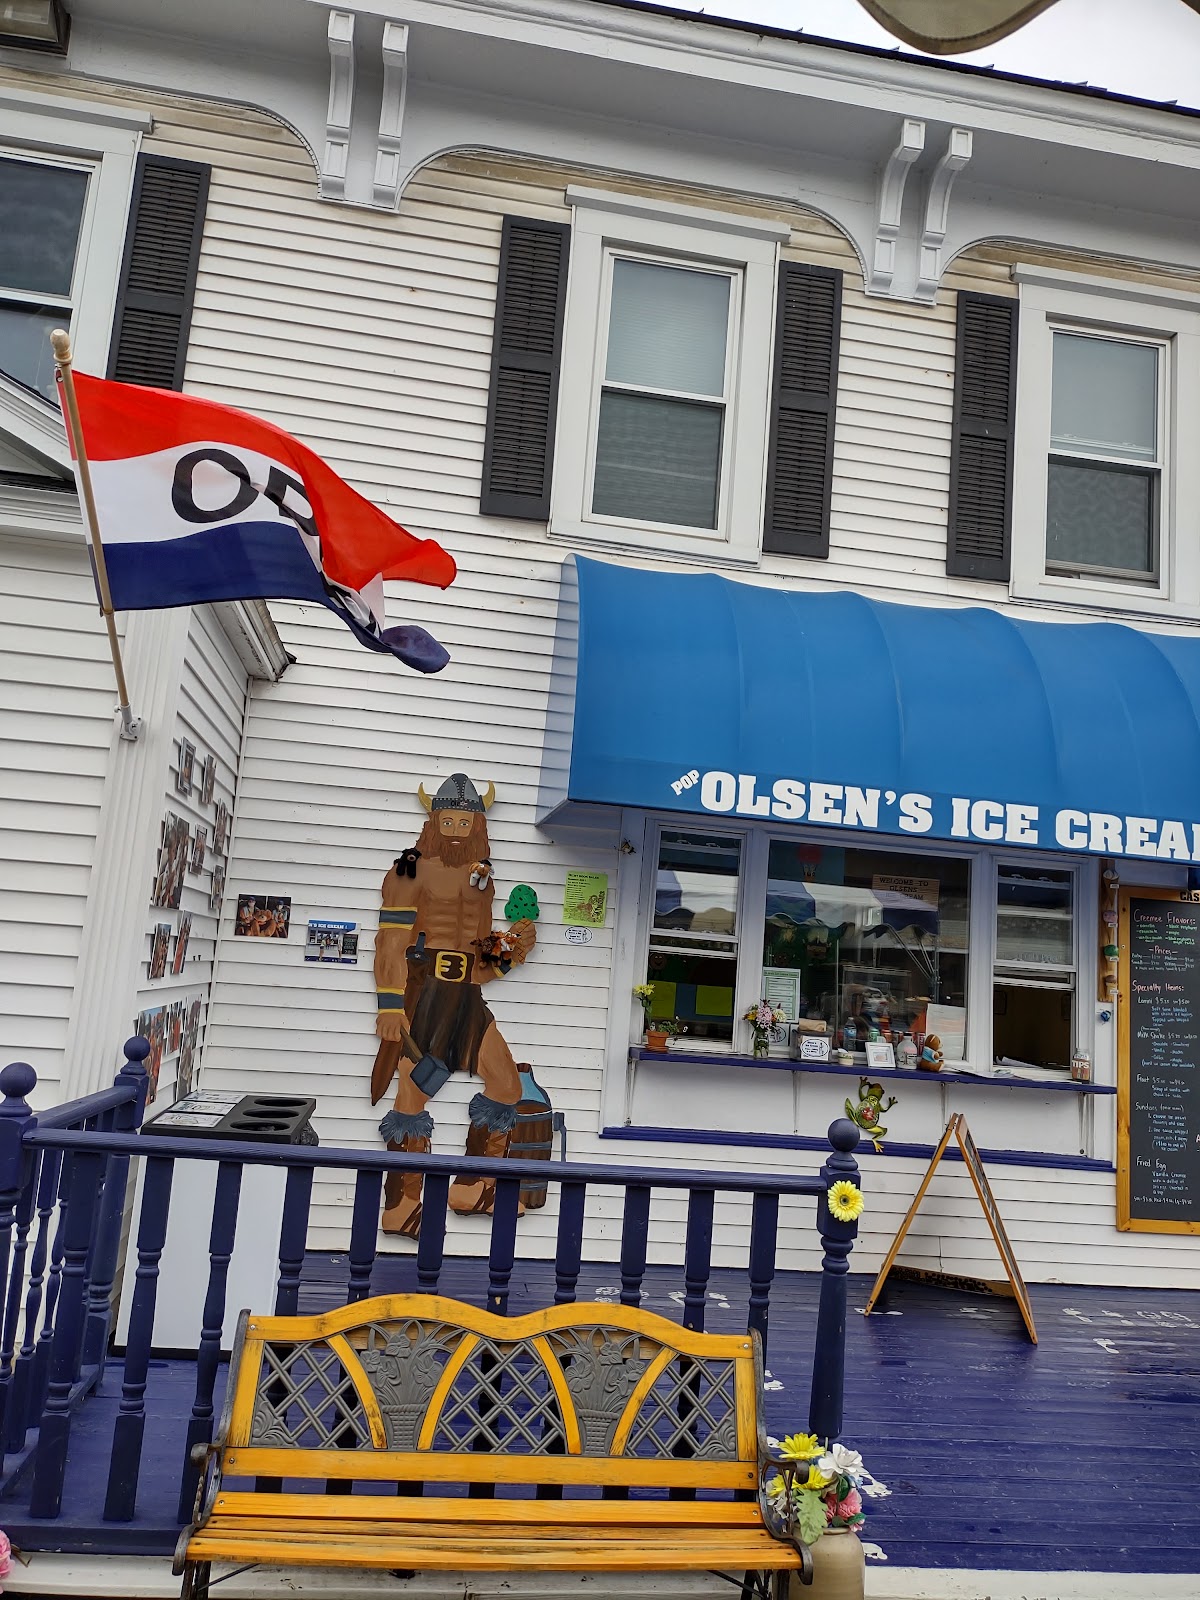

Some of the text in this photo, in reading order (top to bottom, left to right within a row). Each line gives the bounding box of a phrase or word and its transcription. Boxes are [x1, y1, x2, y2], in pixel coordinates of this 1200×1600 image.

[170, 448, 321, 537] OP
[671, 769, 700, 796] POP
[700, 771, 1200, 862] OLSEN'S ICE CREA
[880, 877, 914, 886] WELCOME
[1180, 891, 1200, 902] CAS
[1132, 979, 1184, 995] Specialty Items:
[1150, 1031, 1166, 1040] Shake
[1072, 1059, 1090, 1069] TIPS
[1136, 1073, 1150, 1082] Float
[1136, 1154, 1167, 1171] Fried Egg
